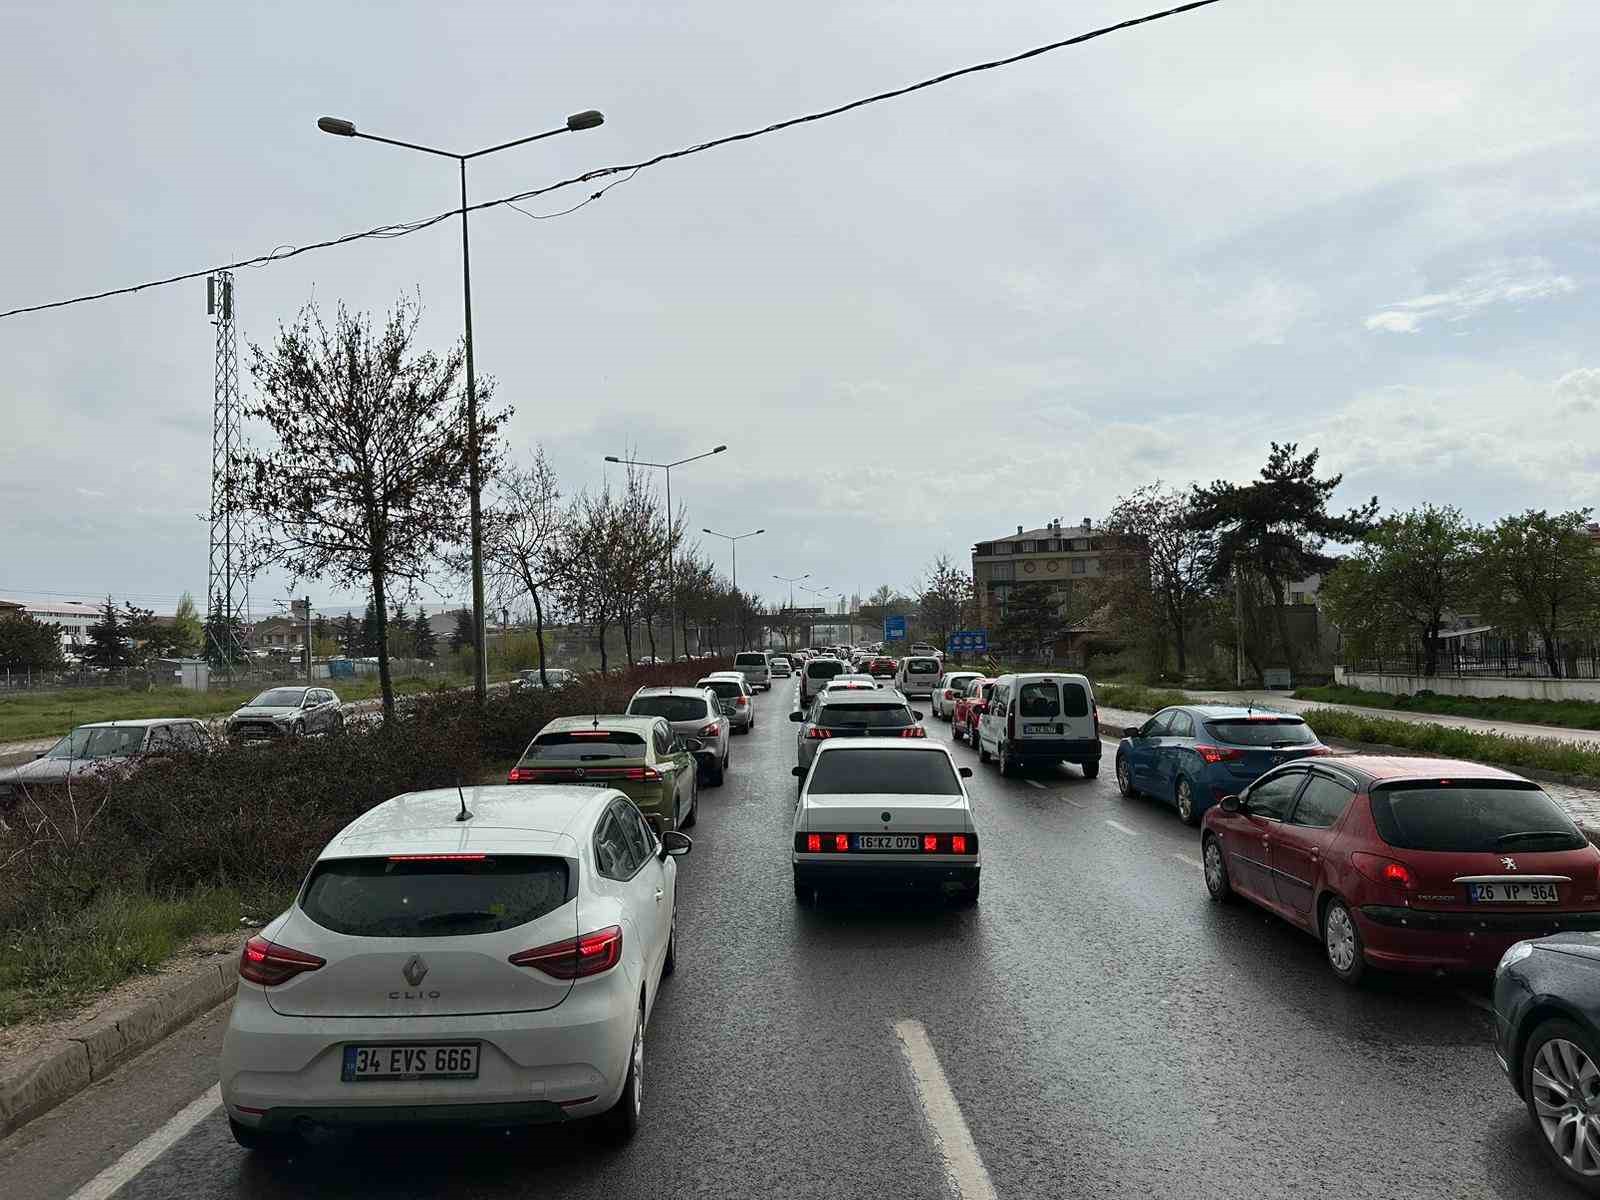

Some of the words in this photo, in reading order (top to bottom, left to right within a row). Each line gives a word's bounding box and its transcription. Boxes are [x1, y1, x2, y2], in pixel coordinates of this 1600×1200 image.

[859, 837, 873, 849] 16
[878, 837, 892, 849] KZ
[896, 837, 918, 849] 070
[1478, 885, 1495, 900] 26
[1503, 885, 1521, 900] VP
[1530, 885, 1557, 900] 964
[388, 990, 441, 1000] CLIO
[357, 1049, 381, 1073] 34
[390, 1049, 427, 1072] EVS
[435, 1049, 471, 1072] 666
